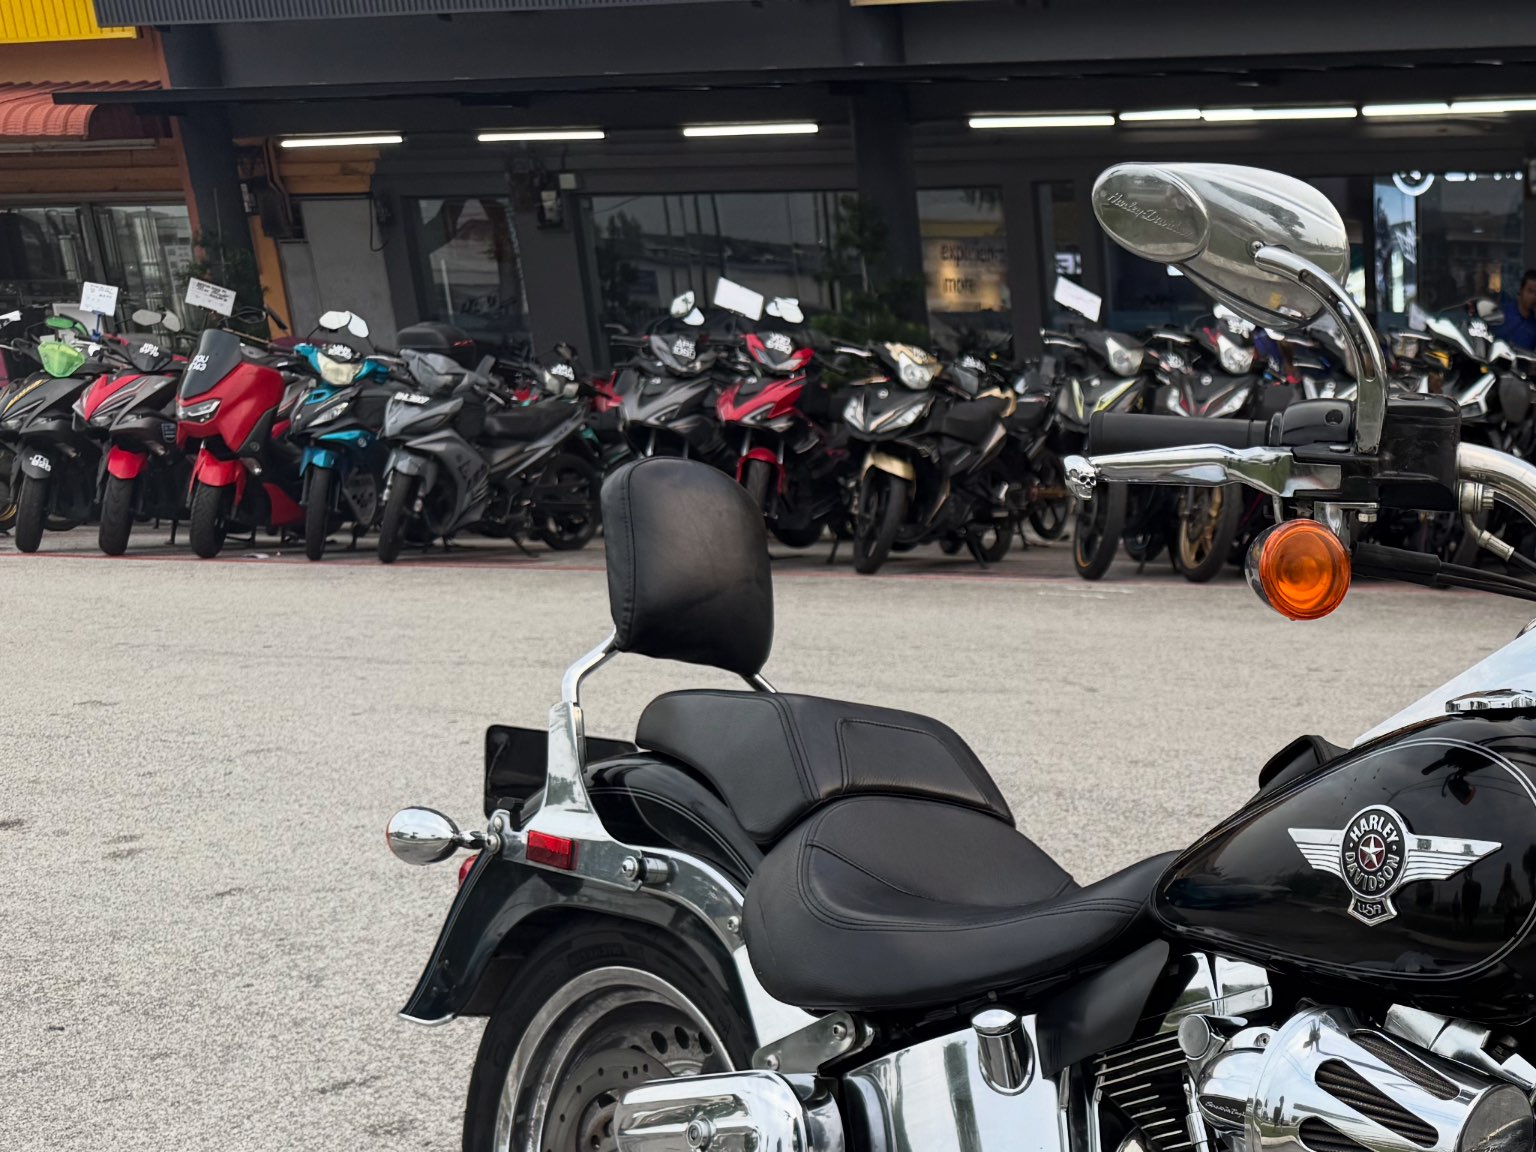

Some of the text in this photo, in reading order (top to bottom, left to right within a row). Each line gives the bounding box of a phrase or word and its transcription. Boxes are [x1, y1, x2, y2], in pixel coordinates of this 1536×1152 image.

[1349, 814, 1400, 844] HARLEY
[1345, 851, 1400, 892] DAVIDSON
[1357, 902, 1382, 916] USA
